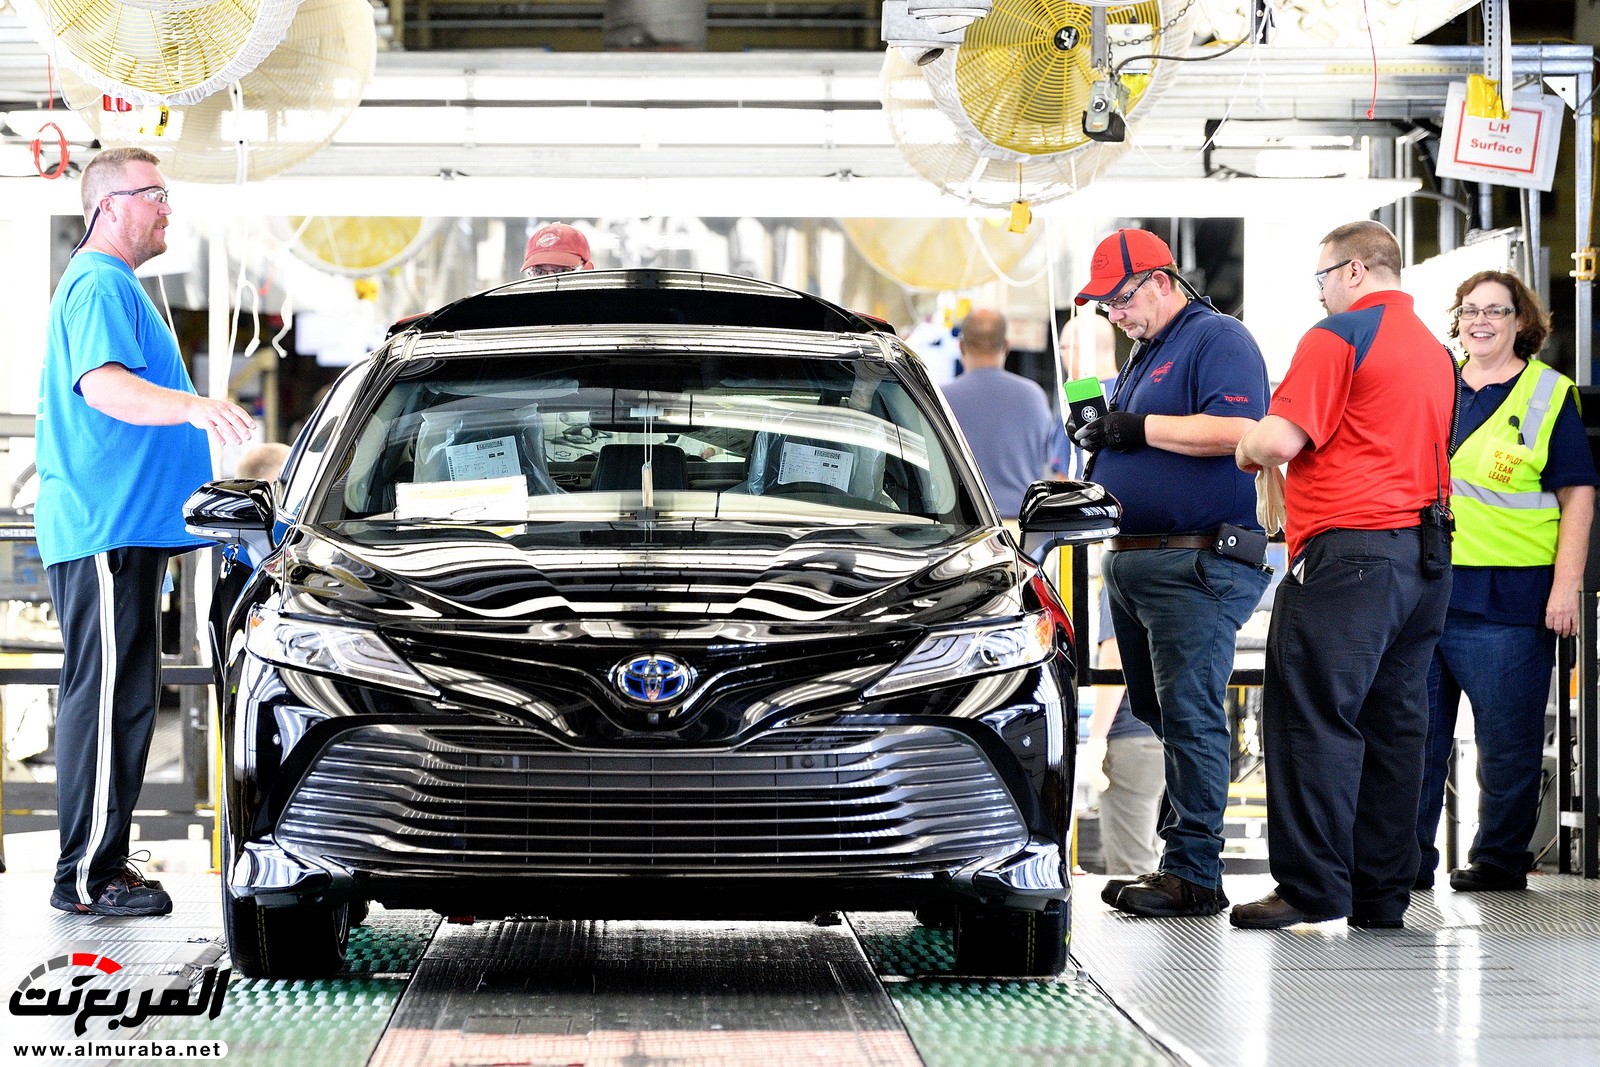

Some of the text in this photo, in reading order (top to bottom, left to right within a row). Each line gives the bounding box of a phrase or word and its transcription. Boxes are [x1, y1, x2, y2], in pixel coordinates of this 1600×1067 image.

[1488, 122, 1510, 133] L/H
[1470, 138, 1522, 154] Surface
[1224, 395, 1249, 403] TOYOTA
[1505, 454, 1522, 465] PILOT
[1495, 462, 1513, 474] TEAM
[1489, 471, 1510, 484] LEADER
